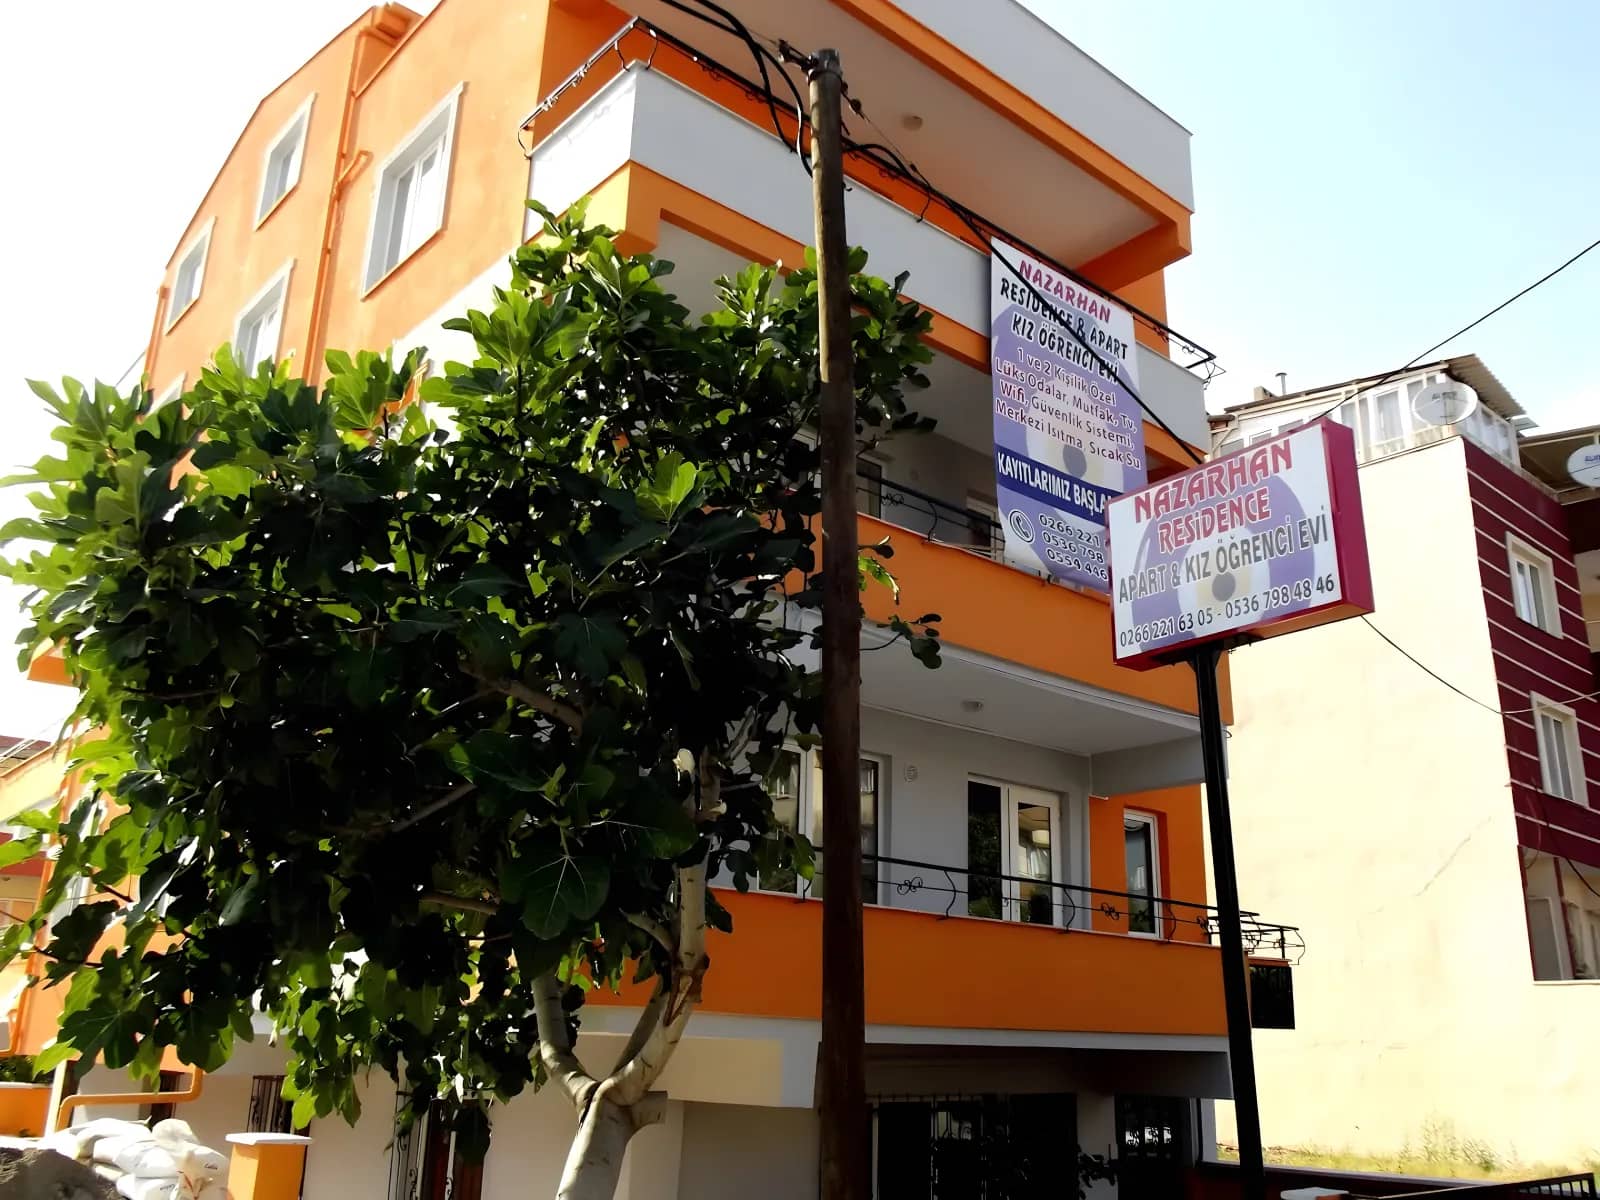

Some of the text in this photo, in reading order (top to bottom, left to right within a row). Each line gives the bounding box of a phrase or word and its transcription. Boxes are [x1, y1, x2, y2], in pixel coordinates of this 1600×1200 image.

[1019, 260, 1111, 323] NAZARHAN
[1012, 313, 1034, 341] KIZ
[1077, 317, 1086, 340] &
[1090, 327, 1128, 360] APART
[996, 358, 1025, 383] Lüks
[1073, 396, 1118, 426] Mutfak,
[1121, 414, 1137, 432] Tv,
[1017, 348, 1116, 406] 1 ve 2 Kişilik Özel
[996, 399, 1044, 431] Merkezi
[1089, 442, 1124, 462] Sıcak
[1126, 454, 1141, 470] Su
[1000, 381, 1135, 449] Wifi, Güvenlik Sistemi,
[997, 452, 1112, 517] KAYITLARIMIZ BAŞLA
[1134, 438, 1293, 523] NAZARHAN
[1039, 514, 1101, 547] 0266 221
[1042, 532, 1104, 565] 0536 798
[1118, 505, 1329, 604] APART & KIZ ÖĞRENCİ EVİ
[1047, 548, 1108, 581] 0554 446
[1120, 621, 1150, 649] 0266
[1152, 616, 1175, 640] 221
[1178, 612, 1194, 632] 63
[1197, 606, 1213, 627] 05
[1225, 593, 1260, 620] 0536
[1263, 585, 1290, 608] 798
[1292, 578, 1312, 600] 48
[1316, 573, 1336, 594] 46
